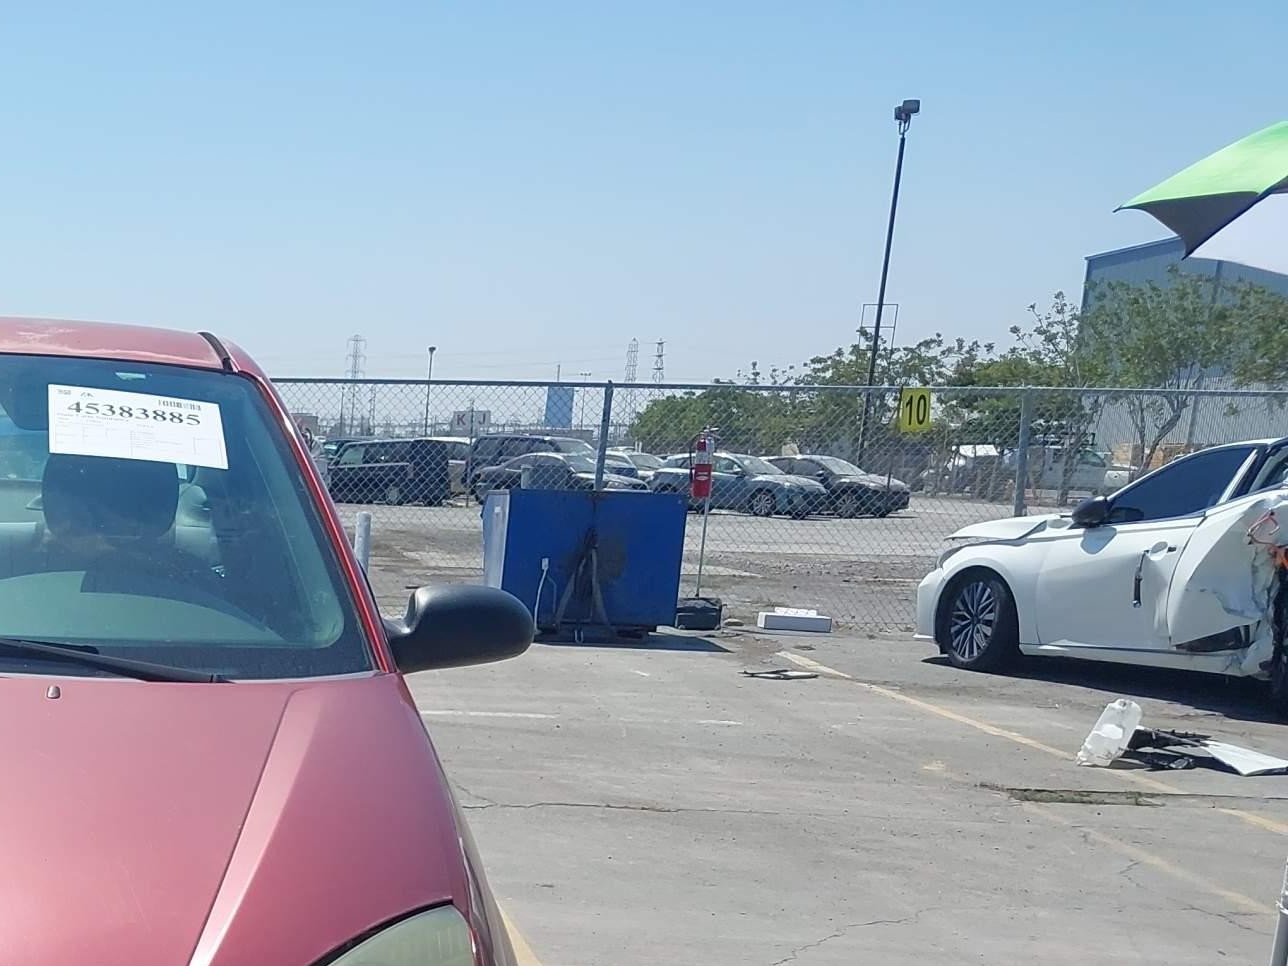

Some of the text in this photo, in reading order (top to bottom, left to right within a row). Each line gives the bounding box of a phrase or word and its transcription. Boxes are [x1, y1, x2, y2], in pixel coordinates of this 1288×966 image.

[67, 401, 202, 426] 45383885
[456, 413, 486, 426] K J
[905, 394, 927, 426] 10
